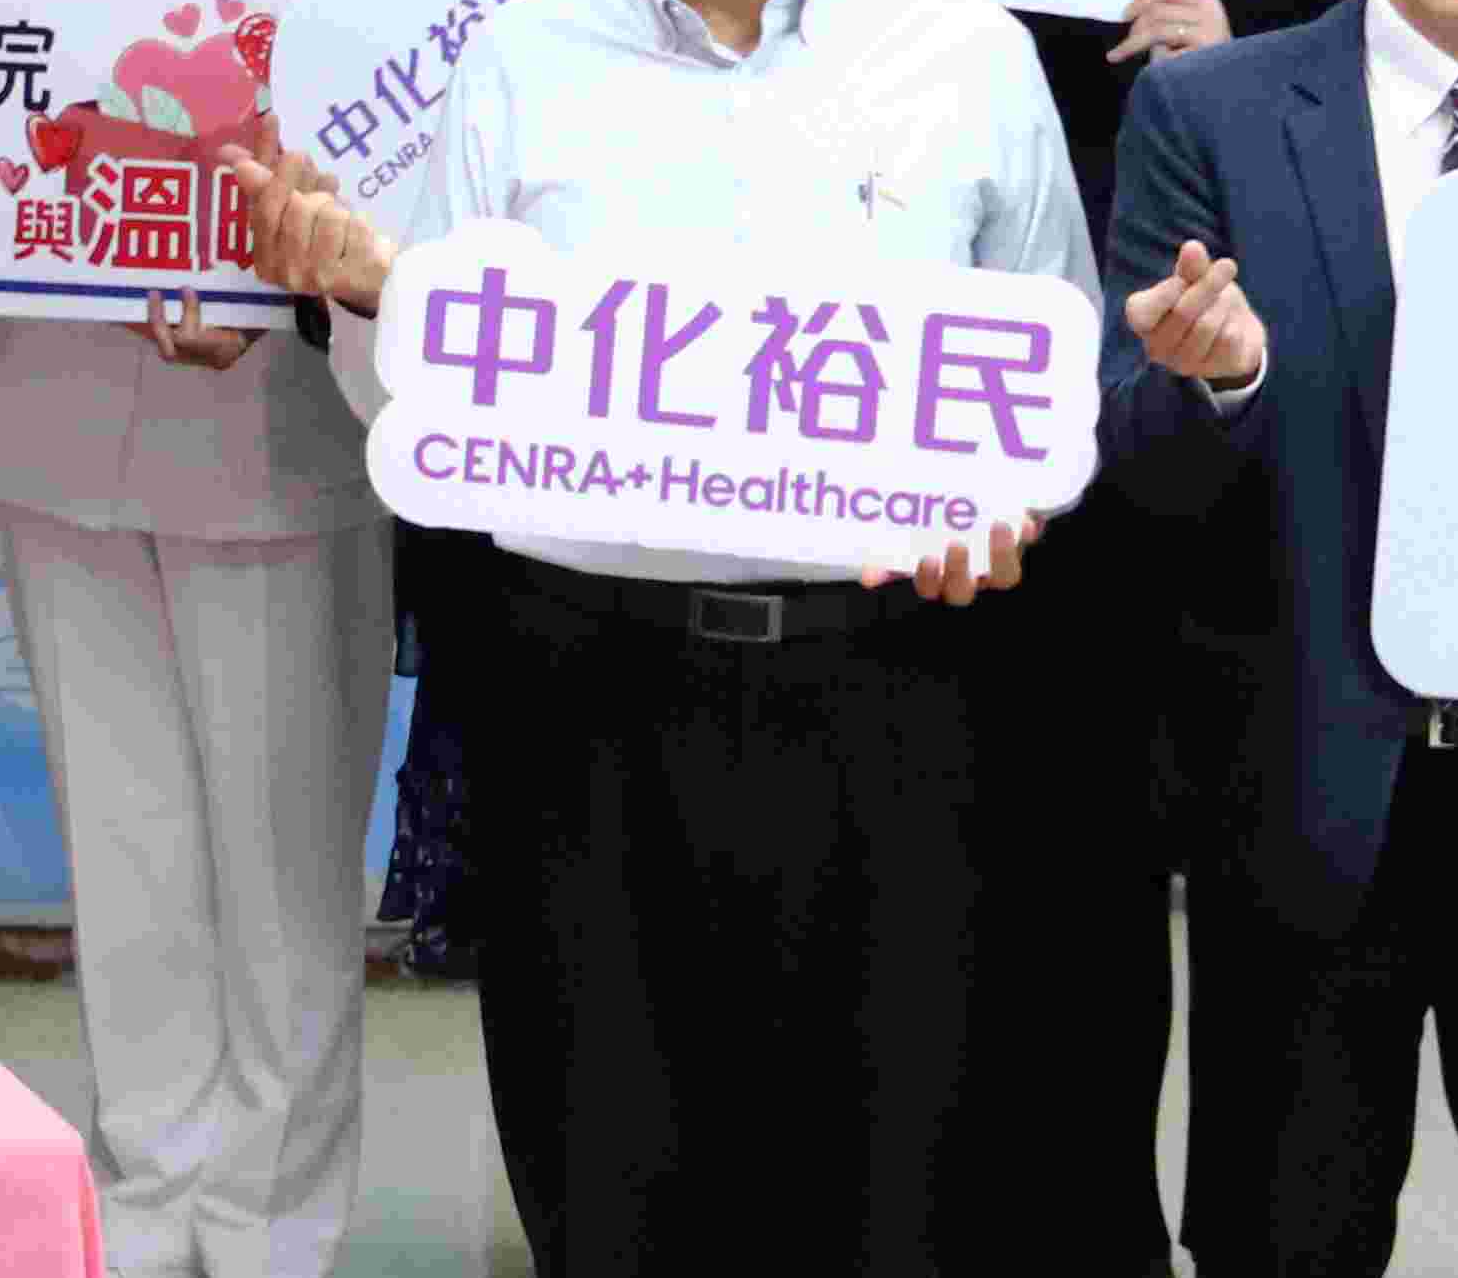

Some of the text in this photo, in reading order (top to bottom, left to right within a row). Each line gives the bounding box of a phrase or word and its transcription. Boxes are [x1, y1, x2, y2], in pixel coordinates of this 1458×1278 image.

[423, 267, 1052, 461] 中化裕民
[414, 432, 979, 532] CENRA+Healthcare
